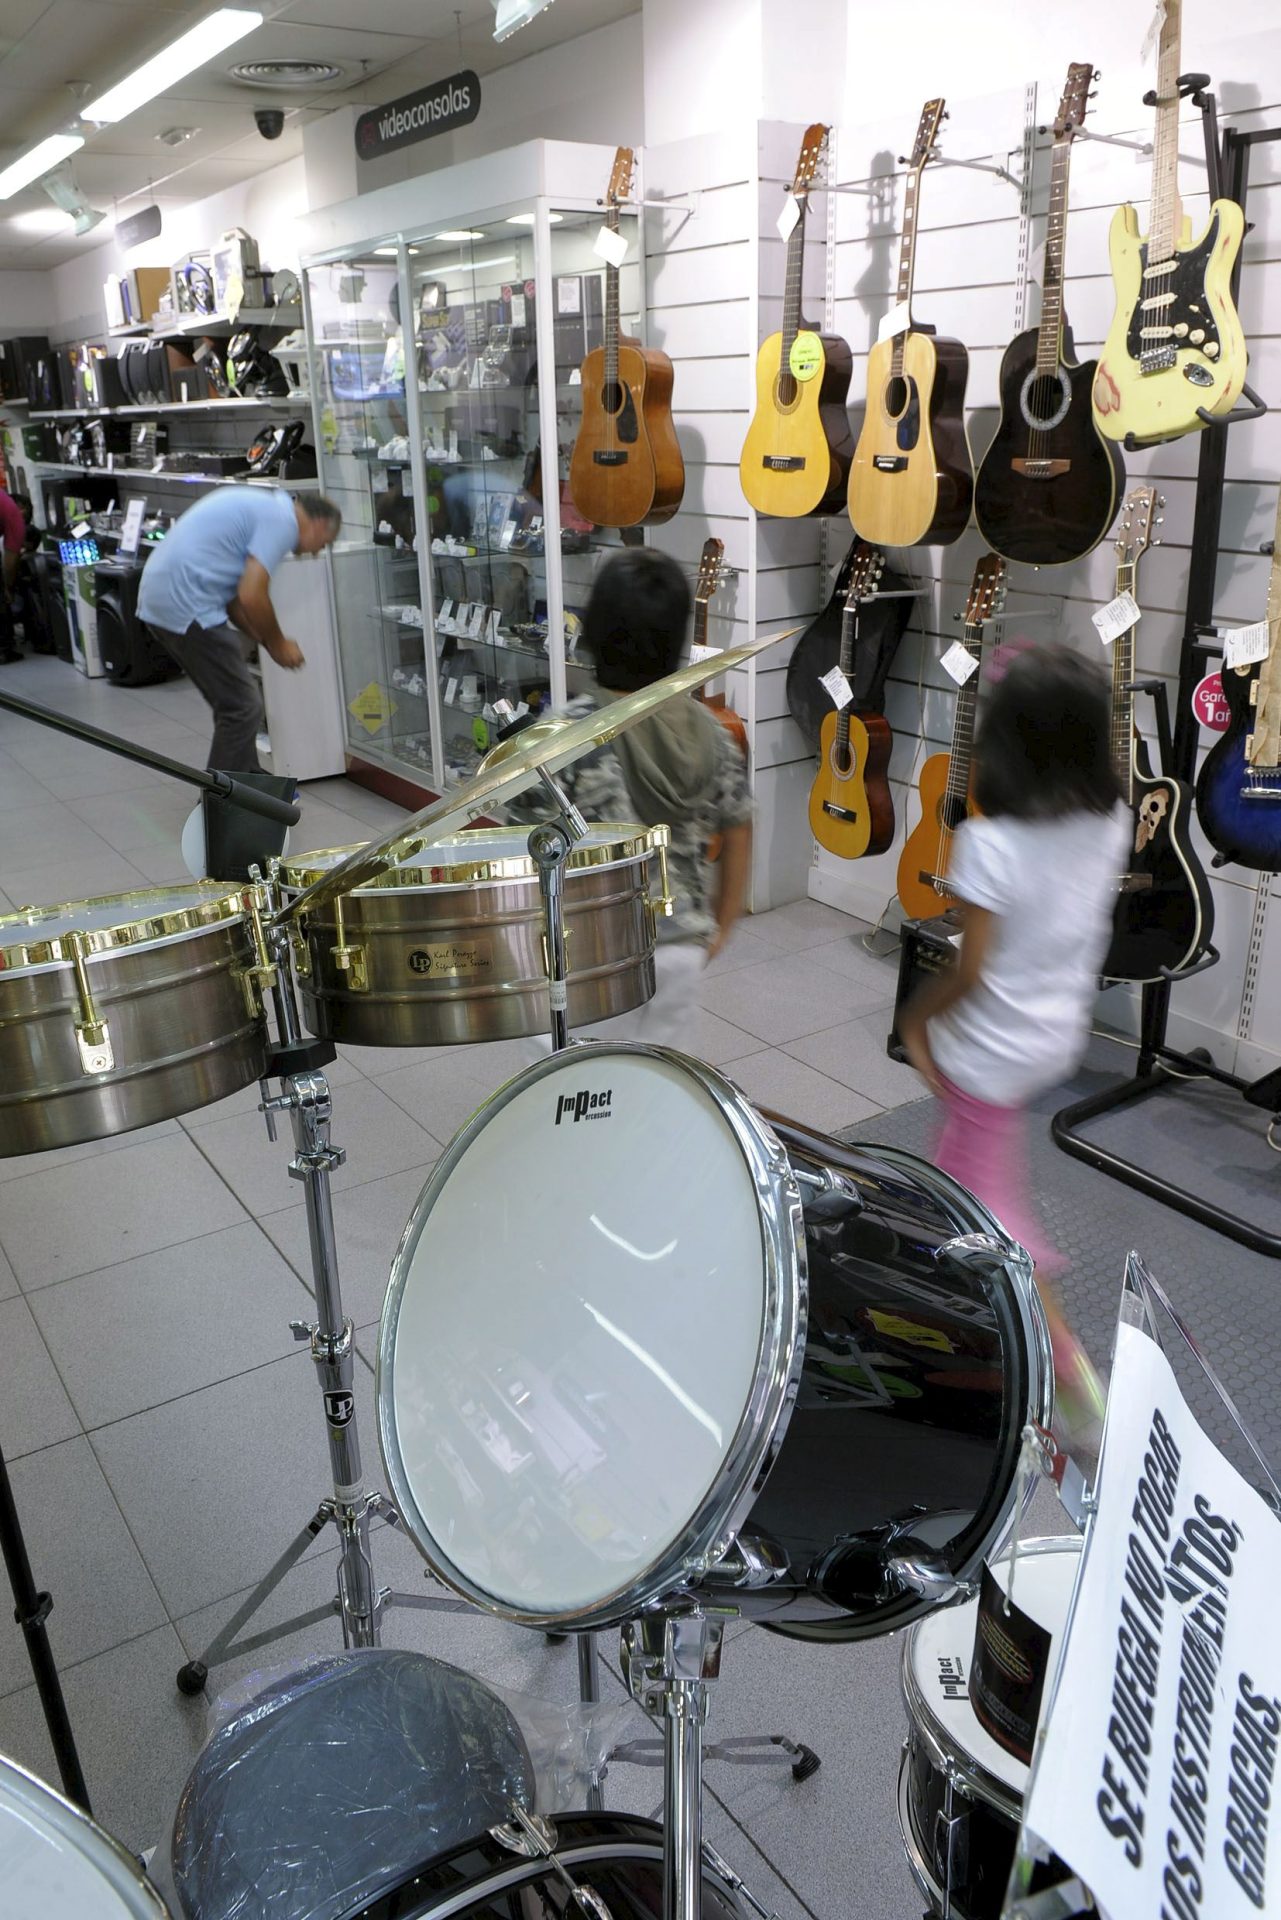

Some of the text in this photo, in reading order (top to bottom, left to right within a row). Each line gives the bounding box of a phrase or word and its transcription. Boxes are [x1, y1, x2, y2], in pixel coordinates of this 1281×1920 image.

[378, 83, 471, 140] videoconsolas
[1205, 702, 1214, 722] 1
[411, 954, 431, 972] LP
[555, 1089, 612, 1125] Impact
[325, 1396, 353, 1421] LP
[1097, 1407, 1181, 1869] SE RUEGA NO TOCAR
[937, 1656, 970, 1701] Impact
[1160, 1828, 1203, 1920] OS
